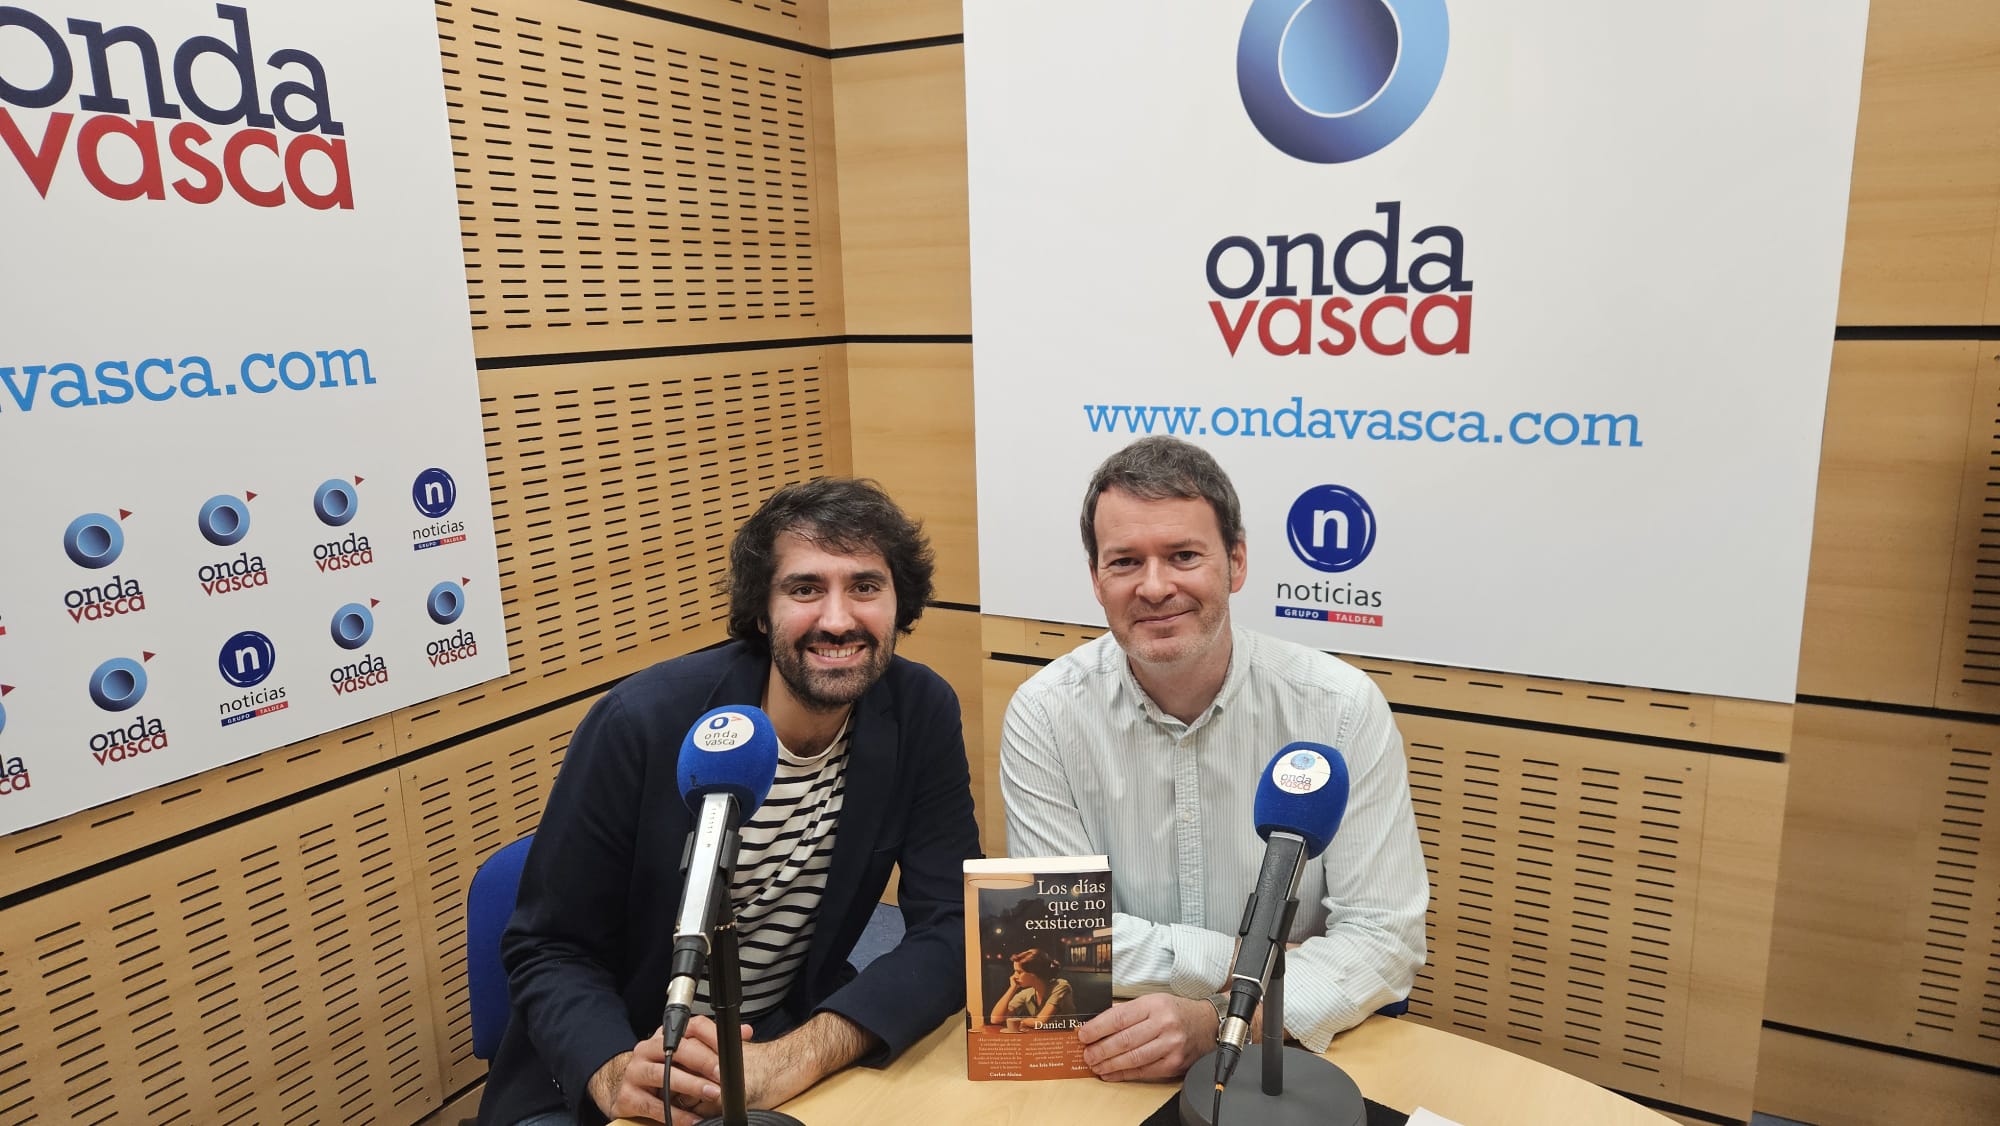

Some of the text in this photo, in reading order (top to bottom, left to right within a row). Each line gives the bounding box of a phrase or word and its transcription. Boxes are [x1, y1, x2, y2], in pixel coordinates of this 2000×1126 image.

[0, 3, 345, 137] onda
[0, 107, 355, 211] vasca
[1206, 201, 1473, 299] onda
[1208, 294, 1473, 358] vasca
[1084, 396, 1644, 448] www.ondavasca.com
[413, 521, 465, 540] noticias
[1313, 509, 1349, 549] n
[314, 532, 372, 560] onda
[198, 552, 266, 583] onda
[316, 549, 374, 573] vasca
[64, 575, 143, 609] onda
[201, 570, 269, 597] vasca
[1277, 580, 1383, 608] noticias
[67, 594, 146, 624] vasca
[1284, 608, 1377, 625] GRUPO TALDEA
[426, 628, 476, 656] onda
[429, 642, 477, 667] vasca
[330, 653, 387, 684] onda
[332, 669, 389, 695] vasca
[219, 686, 286, 715] noticias
[227, 703, 285, 724] GRUPO TALDEA
[89, 715, 166, 752] onda
[704, 730, 738, 740] onda
[705, 738, 735, 747] vasca
[93, 732, 169, 766] vasca
[1280, 773, 1312, 785] onda
[1280, 779, 1312, 791] vasca
[1037, 879, 1106, 895] Los días
[1048, 899, 1106, 916] que no
[1025, 914, 1106, 930] existieron
[1034, 1019, 1066, 1030] Daniel
